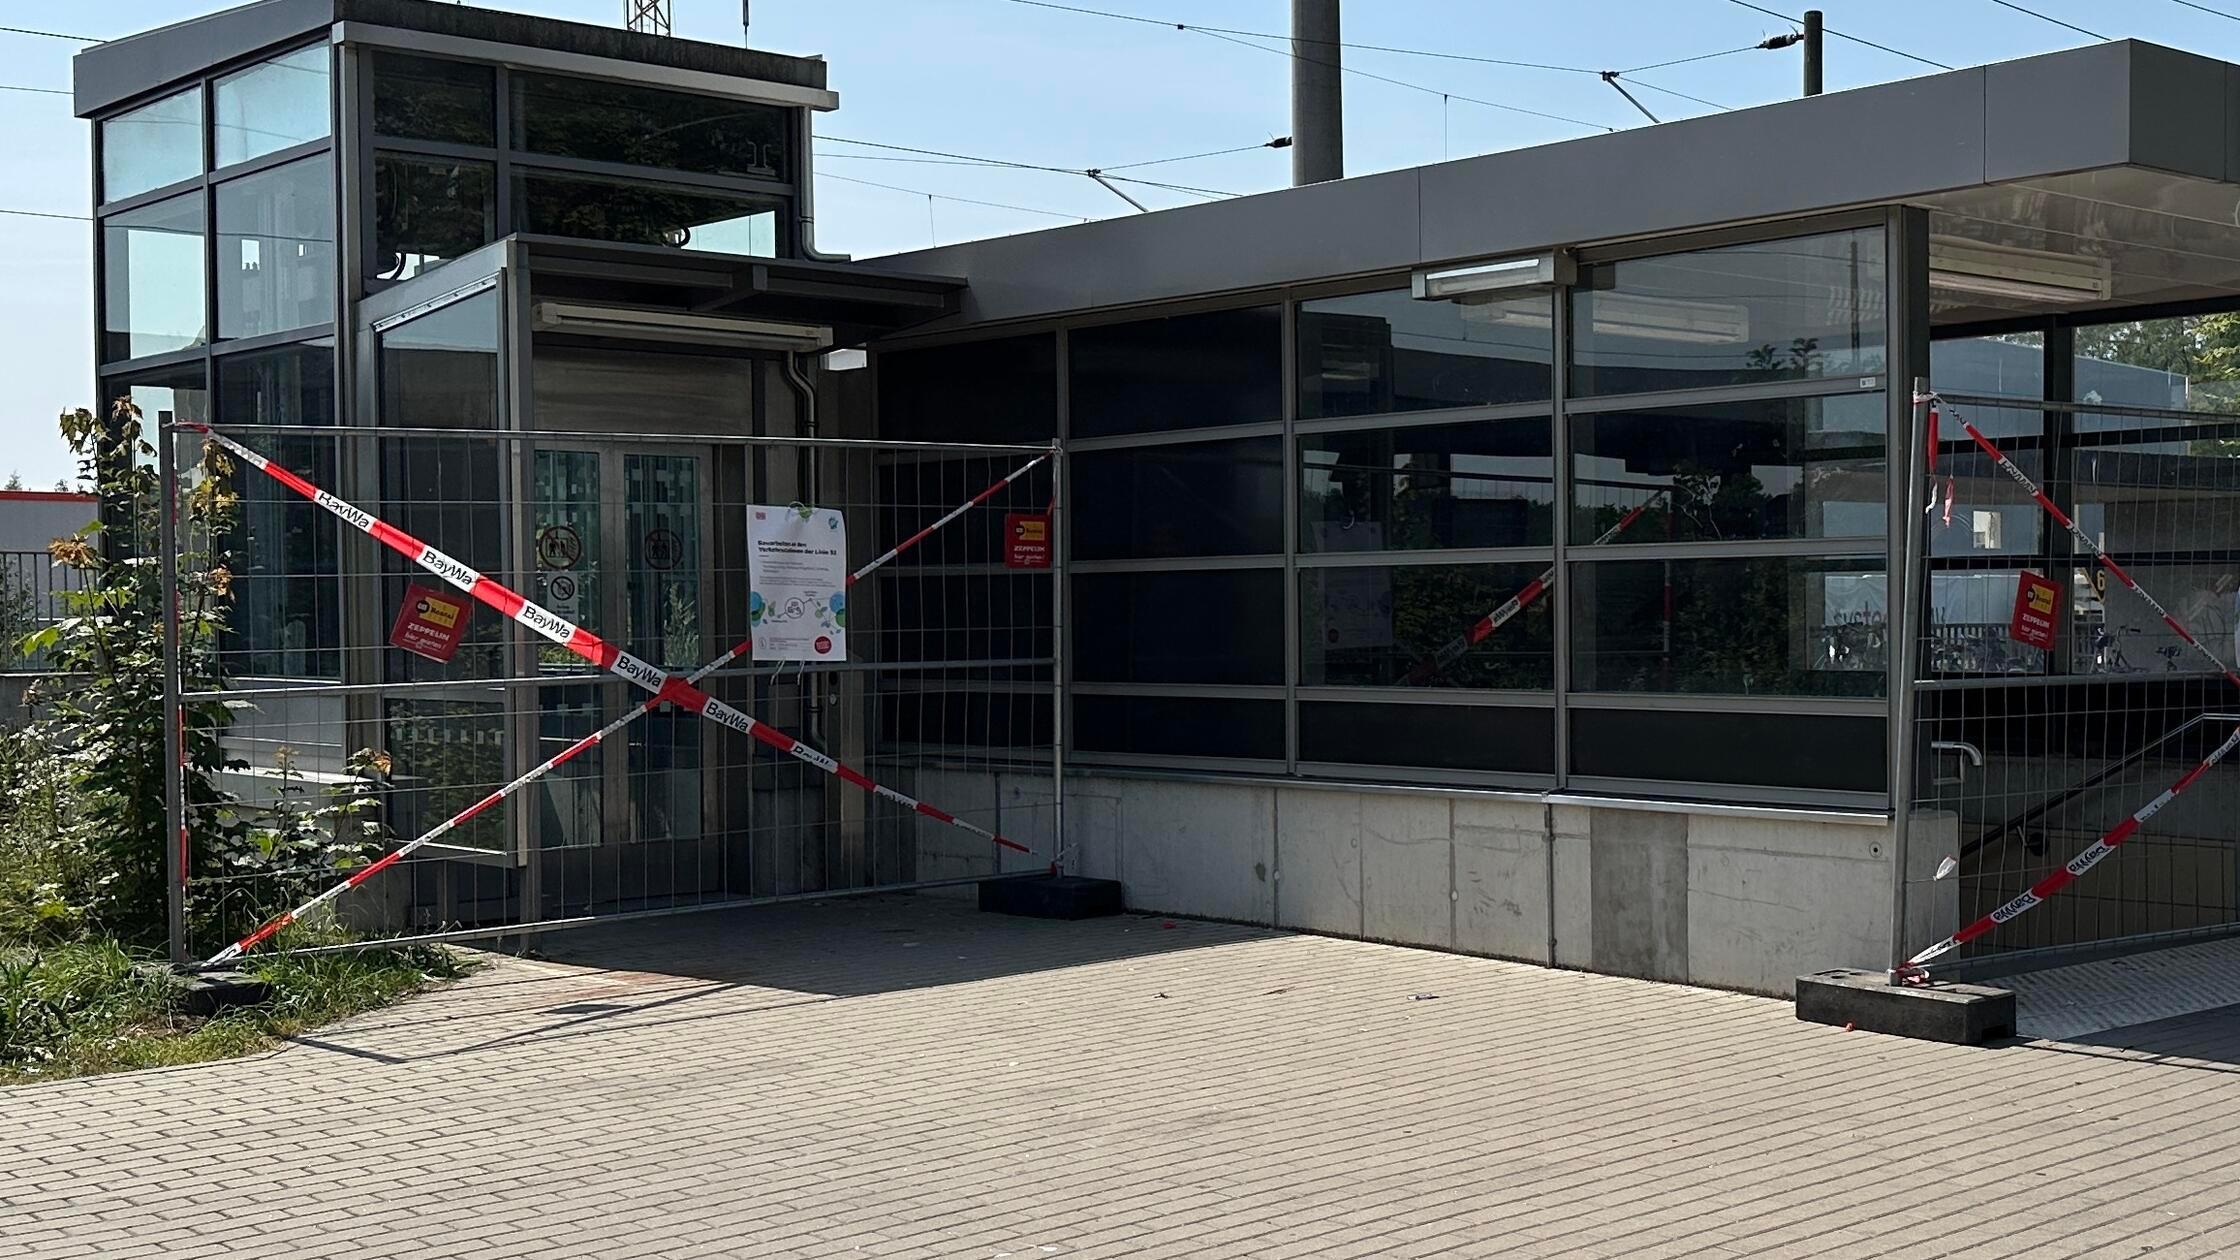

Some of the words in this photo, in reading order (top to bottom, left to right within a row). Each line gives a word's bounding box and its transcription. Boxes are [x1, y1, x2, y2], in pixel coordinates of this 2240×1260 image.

[422, 550, 473, 586] BayWa
[407, 622, 450, 641] ZEPPELIN
[522, 605, 571, 639] BayWa
[617, 655, 663, 688] BayWa
[706, 703, 749, 733] BayWa
[1992, 893, 2036, 921] BayWa
